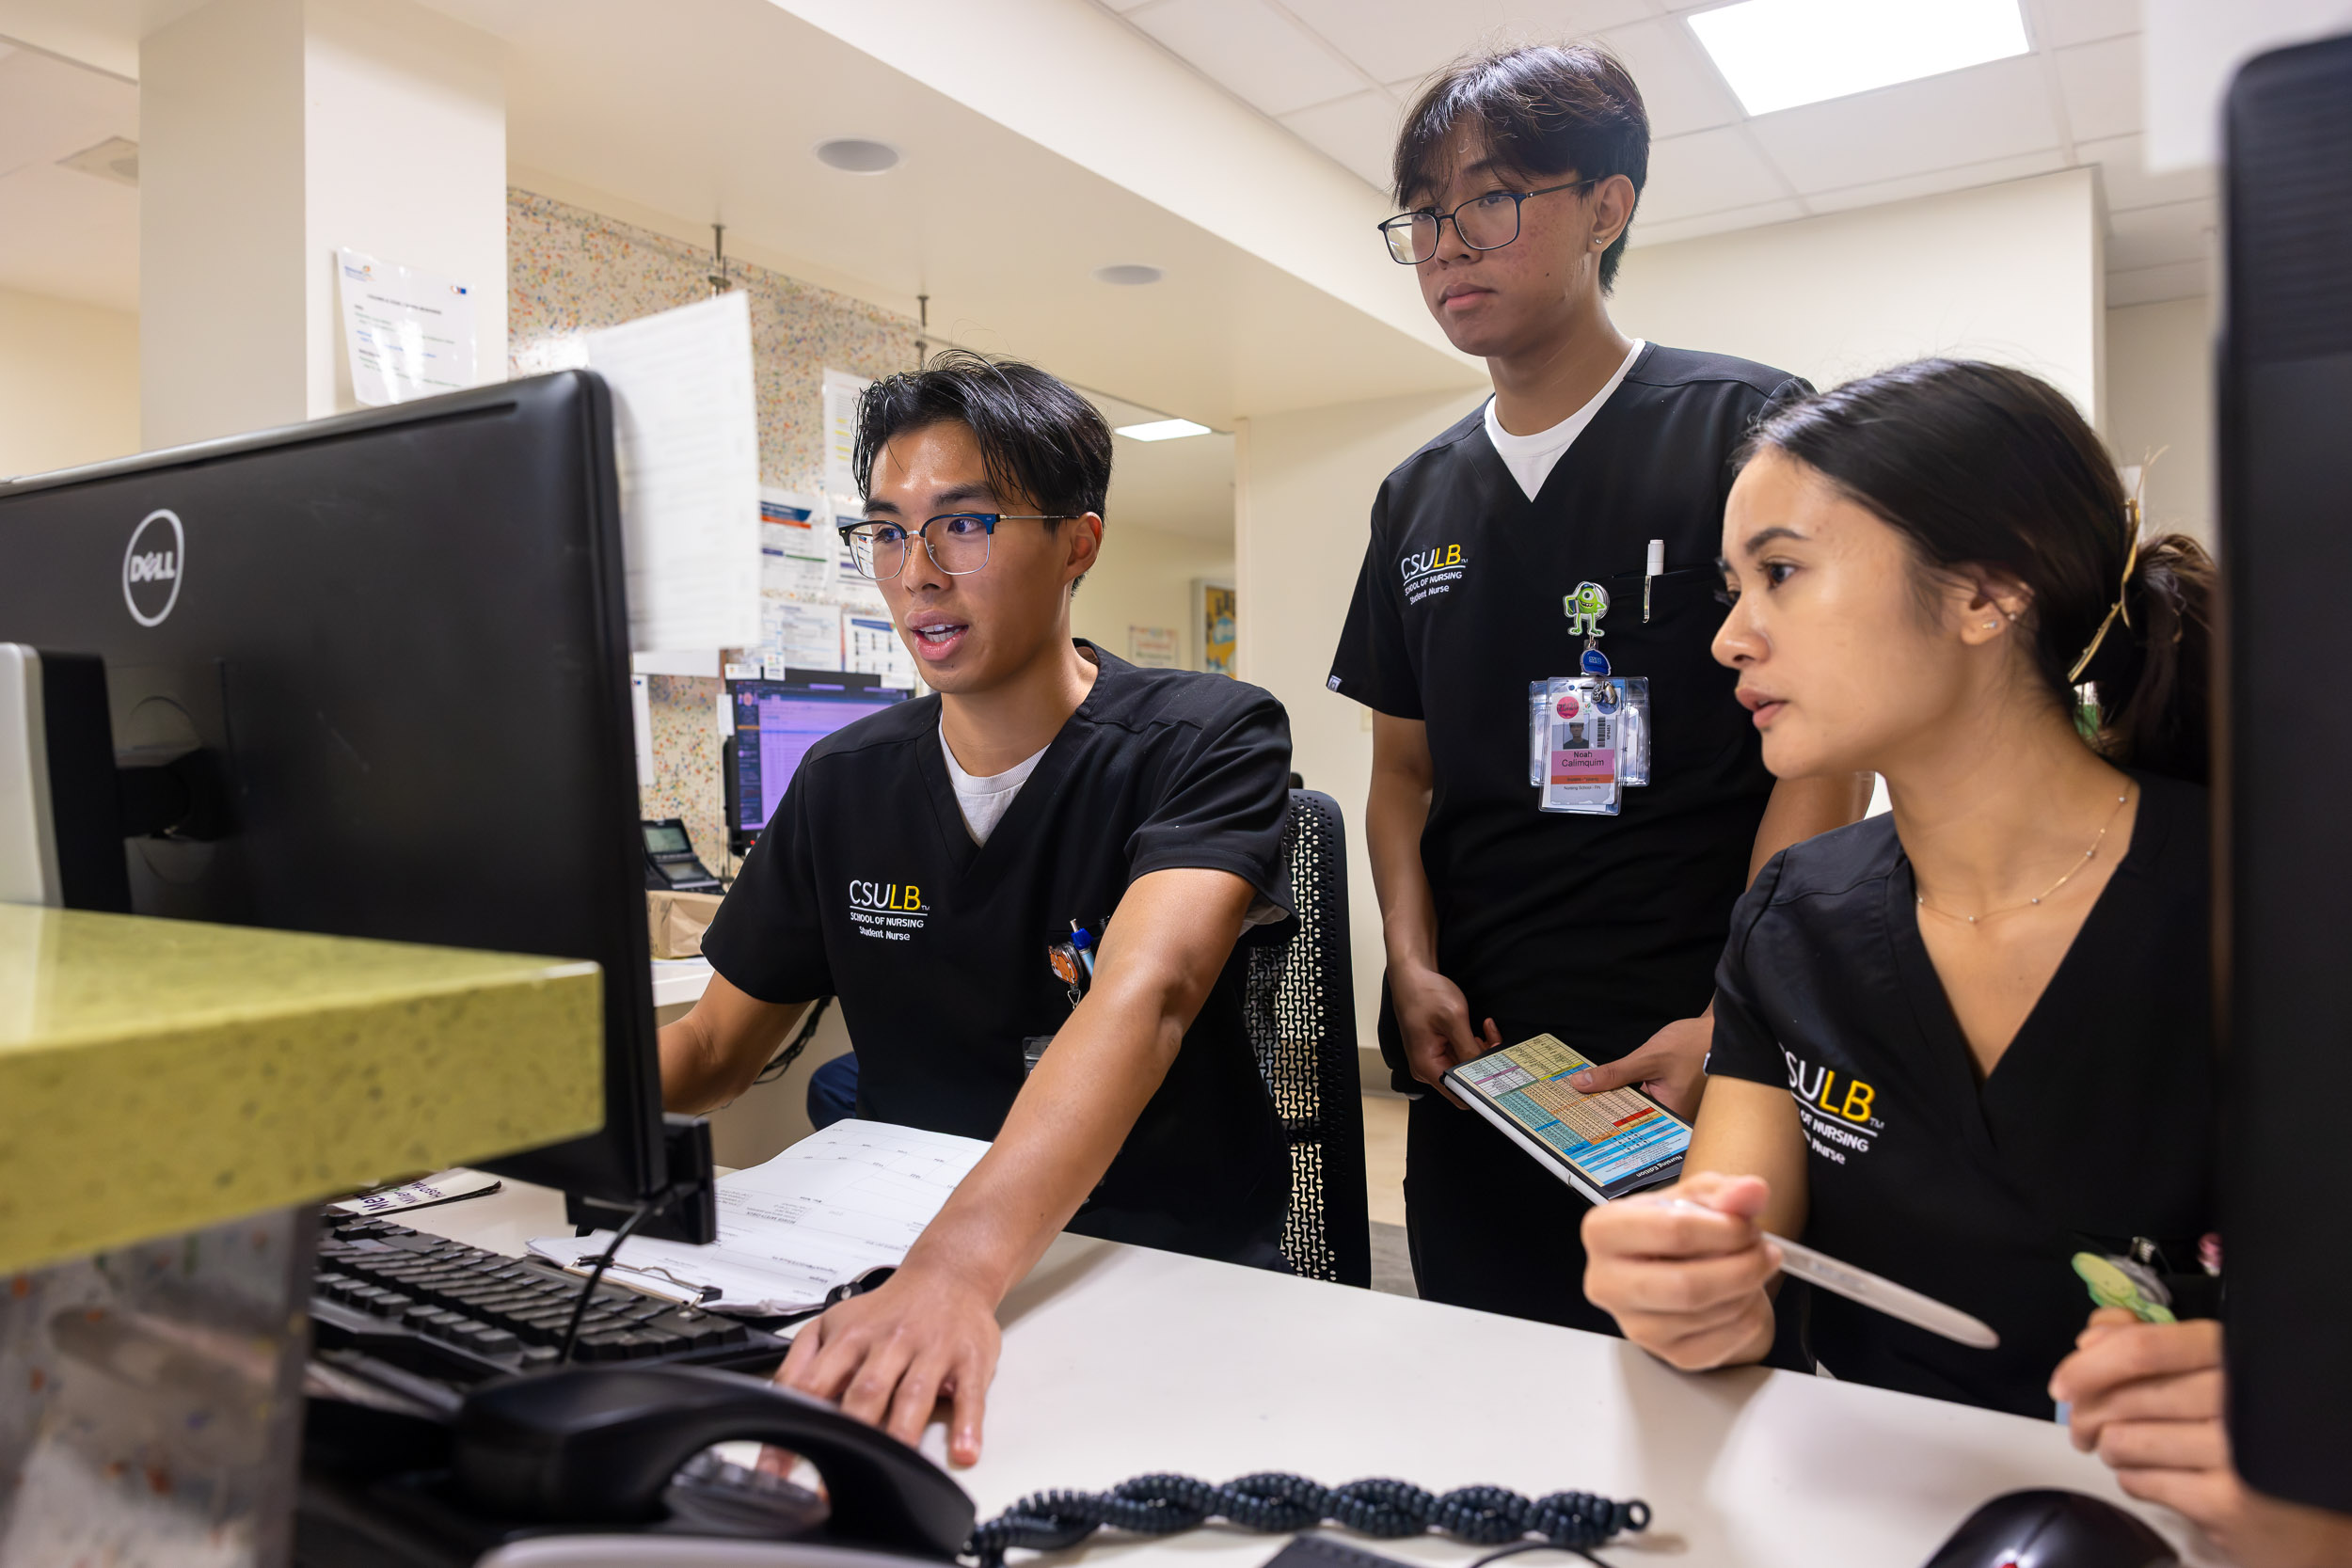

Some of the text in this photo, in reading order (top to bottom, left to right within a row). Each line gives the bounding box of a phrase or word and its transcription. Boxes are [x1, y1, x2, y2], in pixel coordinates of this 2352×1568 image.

[130, 550, 176, 582] DELL
[1401, 544, 1461, 580] CSULB
[1420, 578, 1429, 587] OF
[1429, 571, 1462, 584] NURSING
[1409, 584, 1450, 605] Student Nurse
[1562, 758, 1604, 768] Calimquim
[849, 879, 921, 911] CSULB
[850, 911, 925, 928] SCHOOL OF NURSING
[859, 926, 911, 941] Student Nurse
[1777, 1041, 1876, 1123] SULB
[1812, 1117, 1870, 1153] NURSING
[1811, 1136, 1847, 1165] Nurse
[1635, 1155, 1683, 1178] Nursing Edition
